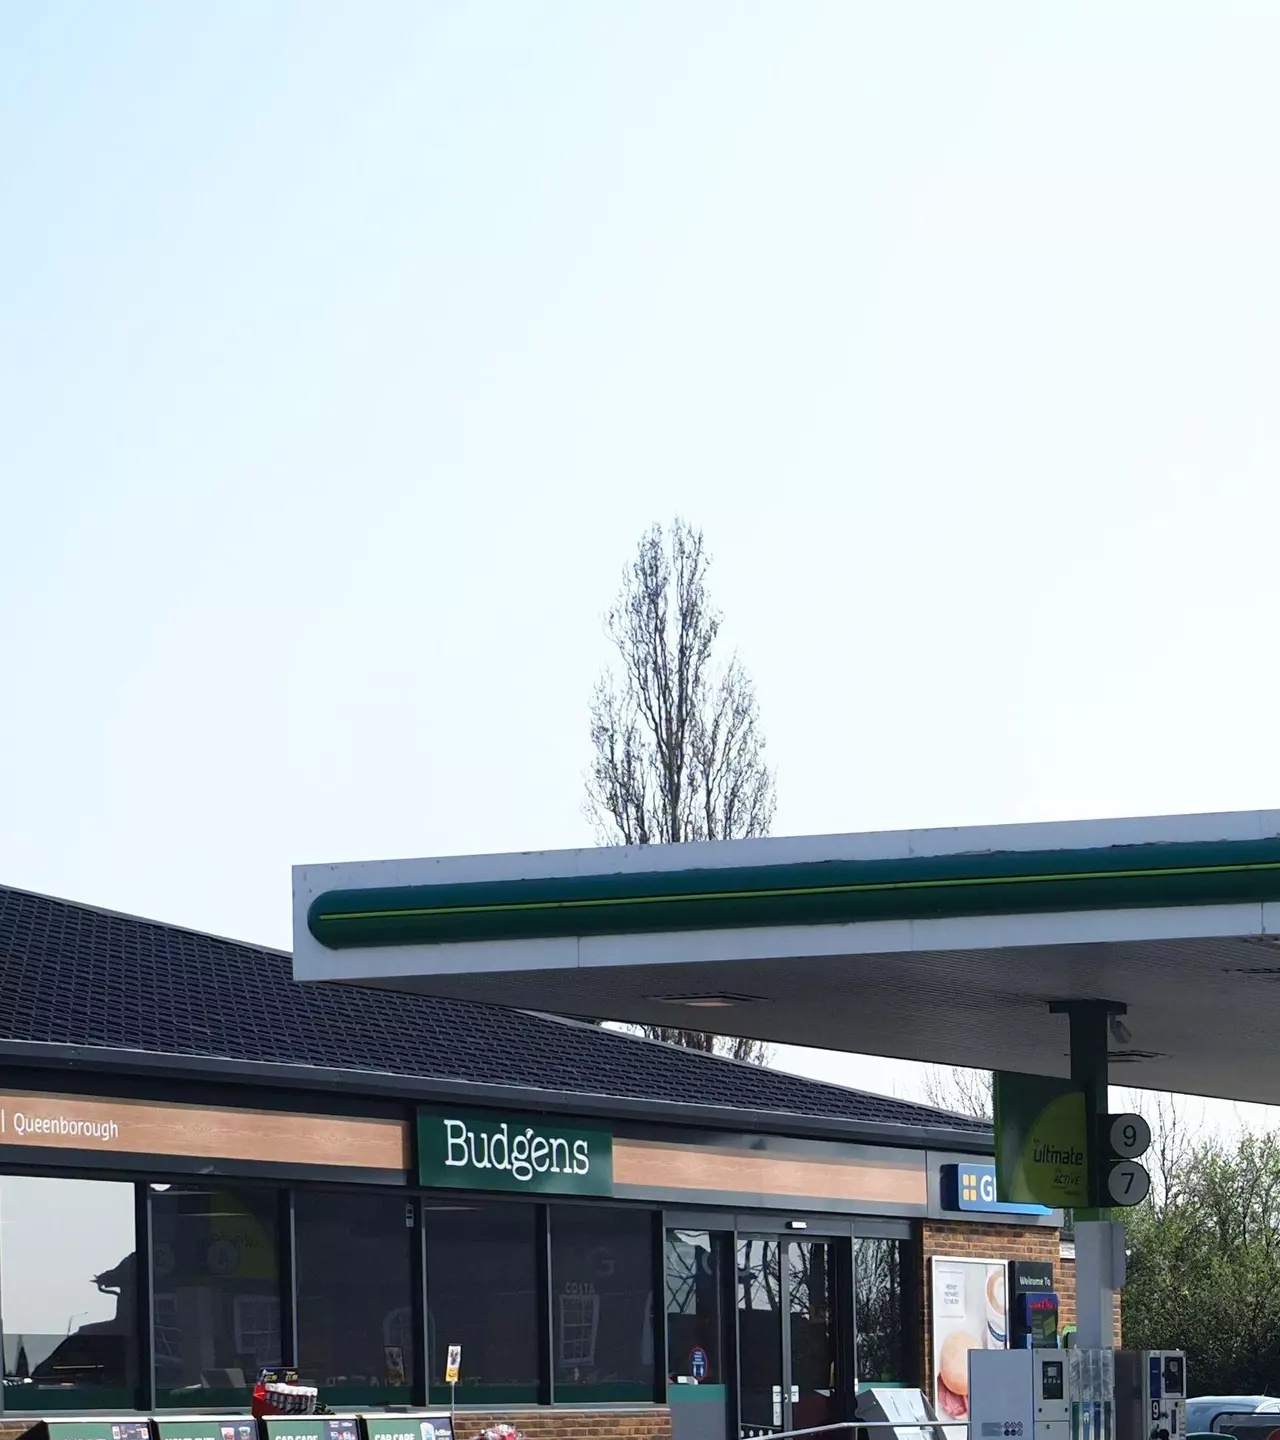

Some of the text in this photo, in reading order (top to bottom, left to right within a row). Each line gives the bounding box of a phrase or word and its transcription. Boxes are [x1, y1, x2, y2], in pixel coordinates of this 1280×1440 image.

[13, 1112, 119, 1142] Queenborough
[1122, 1125, 1137, 1147] 9
[443, 1119, 590, 1181] Budgens
[1033, 1144, 1084, 1166] ultimate
[1120, 1173, 1135, 1194] 7
[1152, 1401, 1160, 1419] 9
